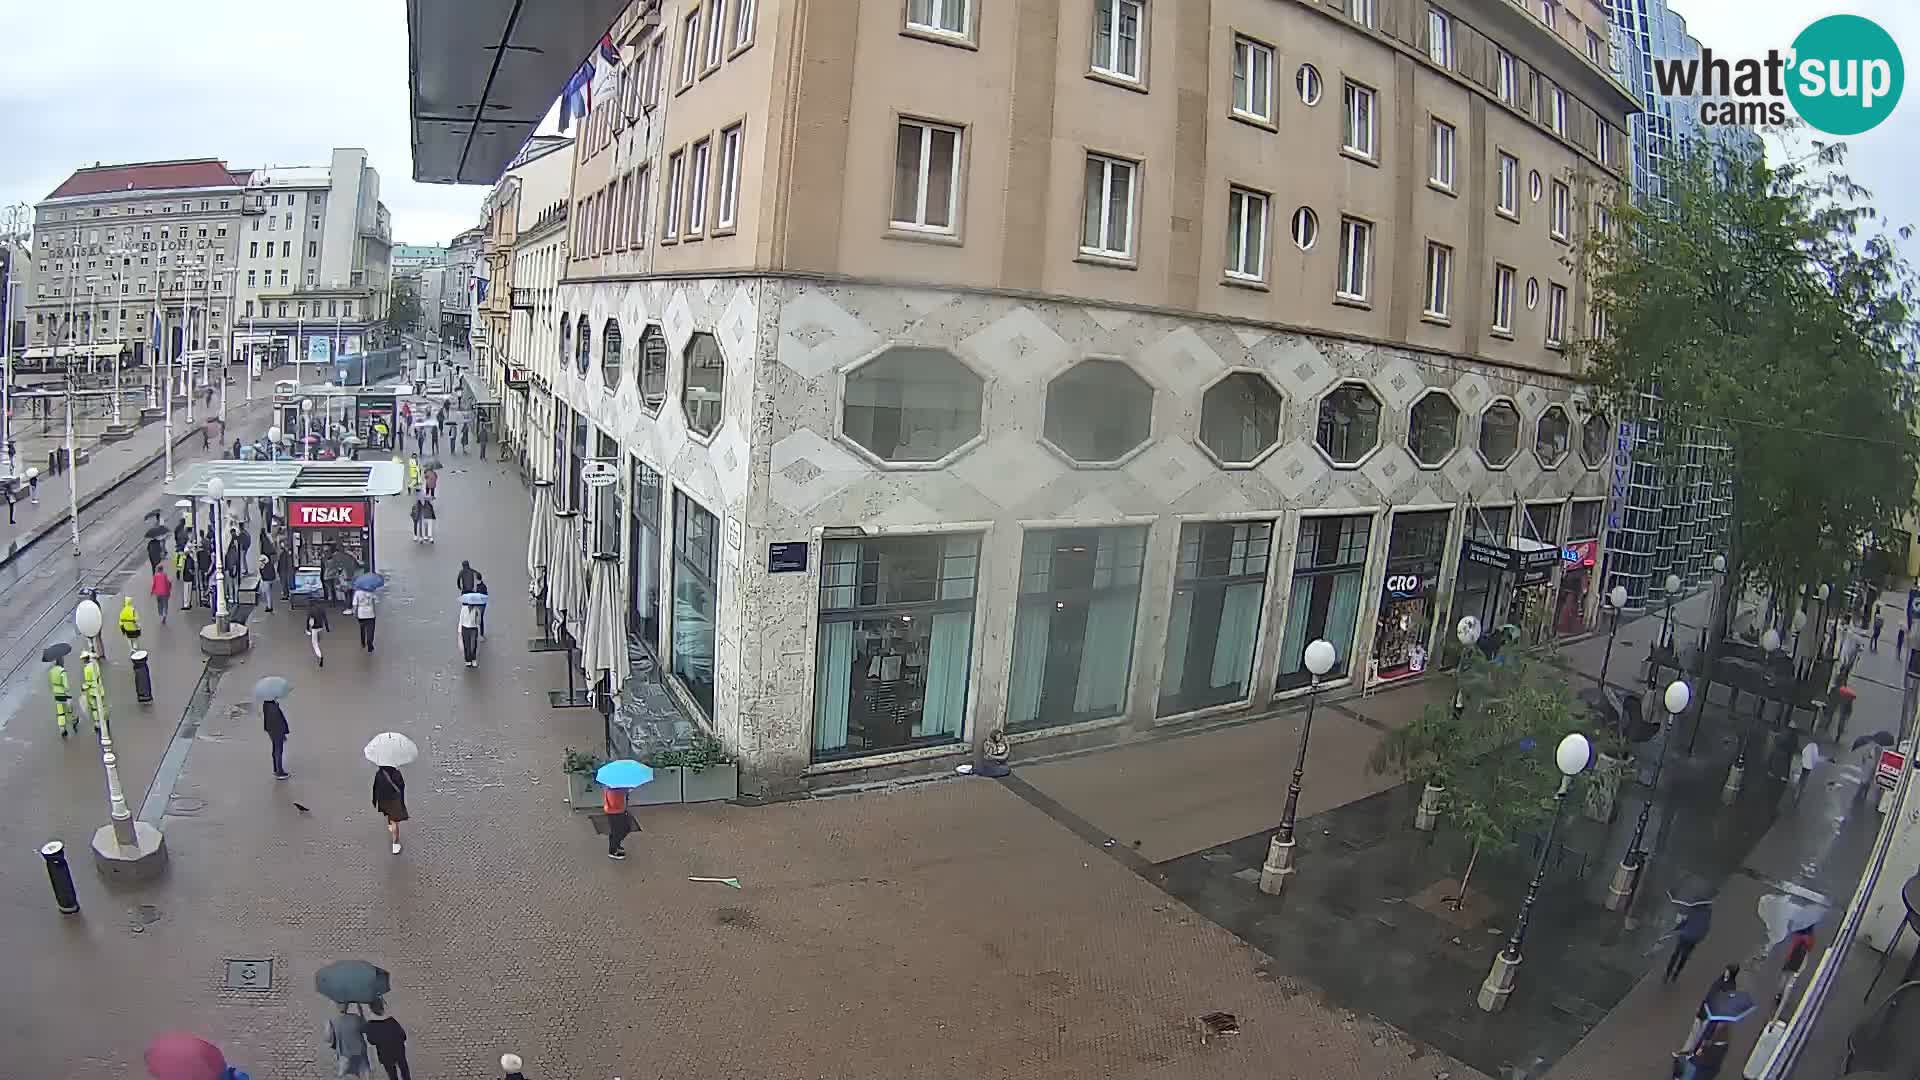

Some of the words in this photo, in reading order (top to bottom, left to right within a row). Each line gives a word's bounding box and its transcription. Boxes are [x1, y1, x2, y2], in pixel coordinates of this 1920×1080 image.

[120, 239, 214, 252] EDIONICA
[1607, 423, 1633, 529] BROVNIK
[300, 506, 353, 523] TISAK
[1387, 575, 1418, 591] CRO
